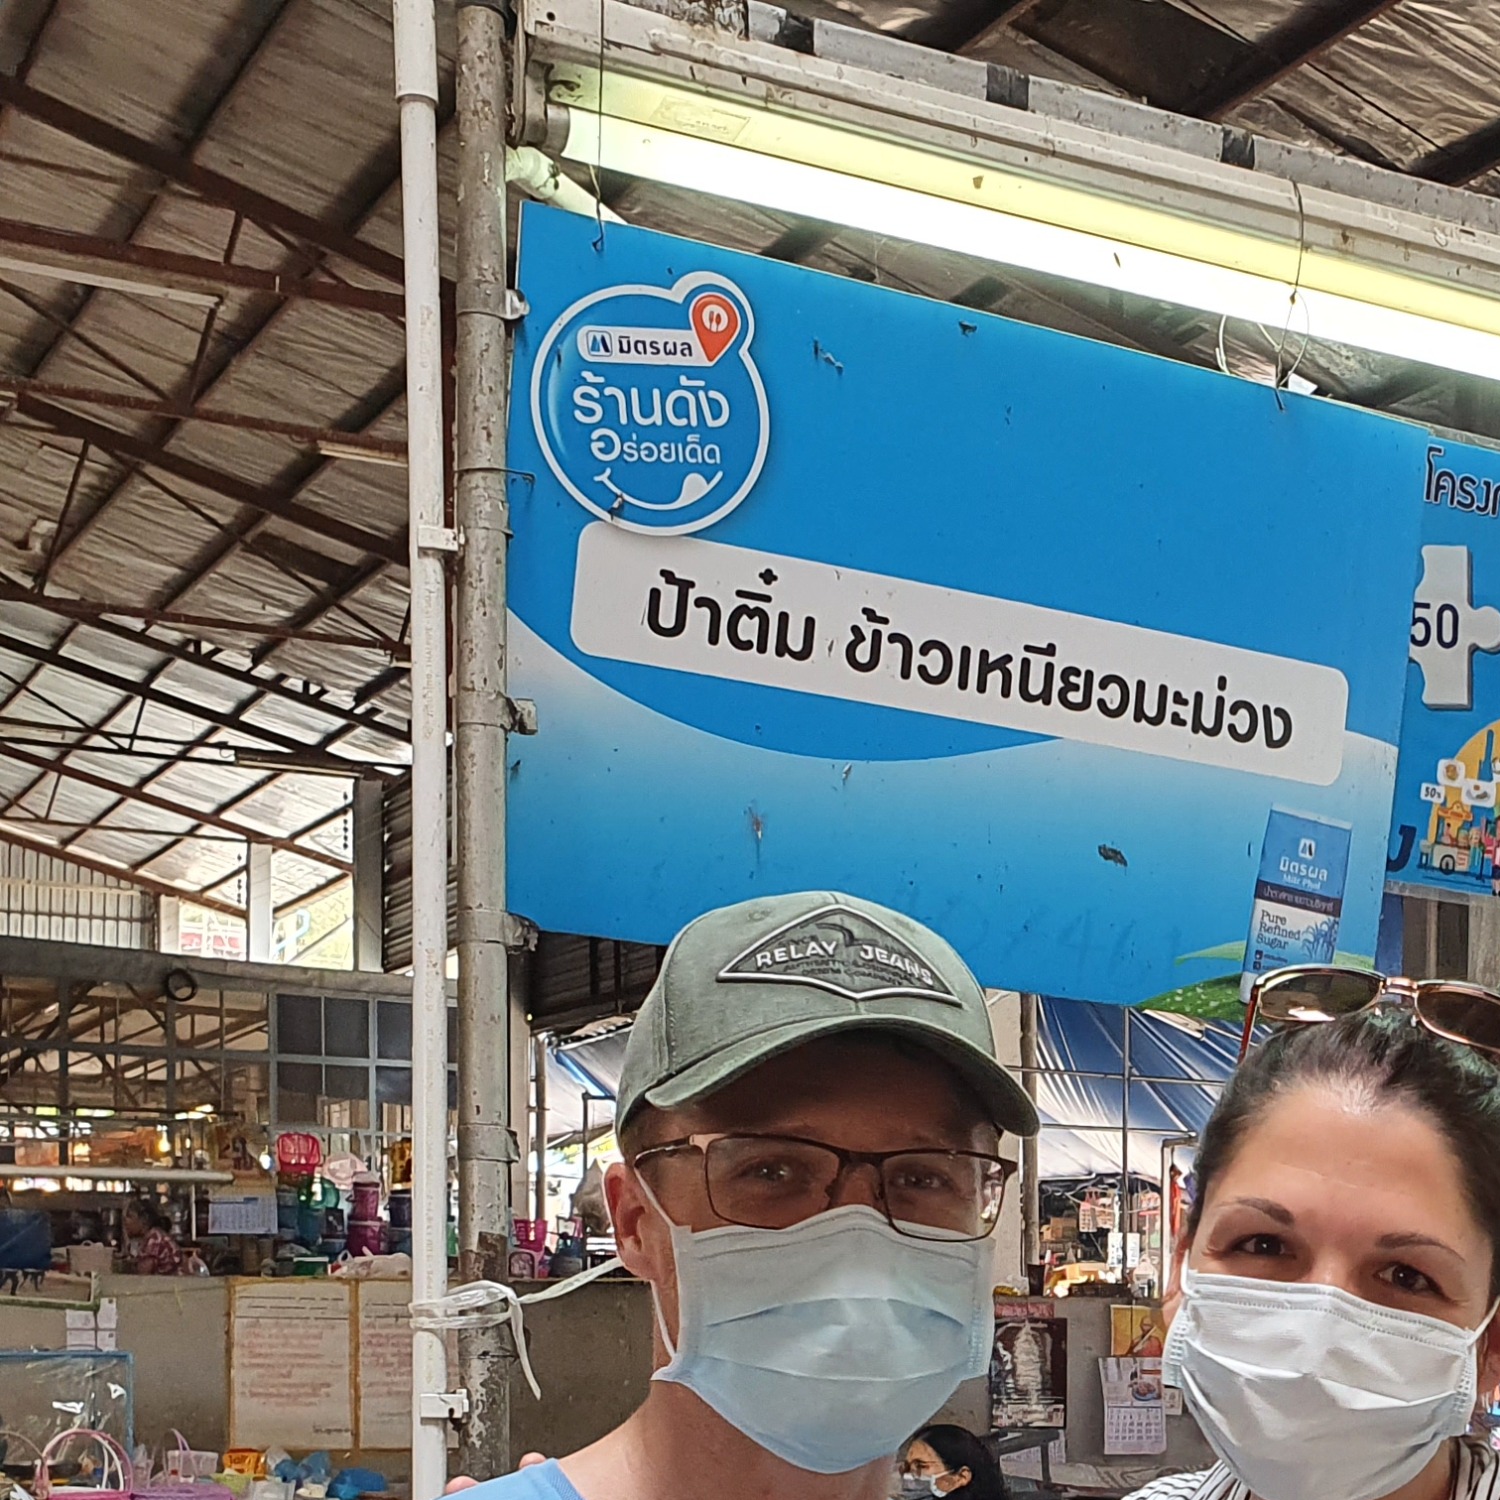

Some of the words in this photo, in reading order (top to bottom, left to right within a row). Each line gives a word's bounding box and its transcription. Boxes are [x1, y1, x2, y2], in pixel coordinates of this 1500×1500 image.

[618, 336, 693, 357] มิตรผล
[573, 370, 730, 428] ร้านดัง
[590, 427, 720, 464] อร่อยเด็ด
[1411, 602, 1459, 649] 50
[647, 568, 816, 661] ป้าติ๋ม
[845, 606, 1292, 749] ข้าวเหนียวมะม่วง
[1259, 921, 1301, 941] Refined
[1261, 910, 1287, 926] Pure
[1256, 933, 1289, 950] Sugar
[756, 941, 837, 968] RELAY
[860, 944, 934, 985] JEANS
